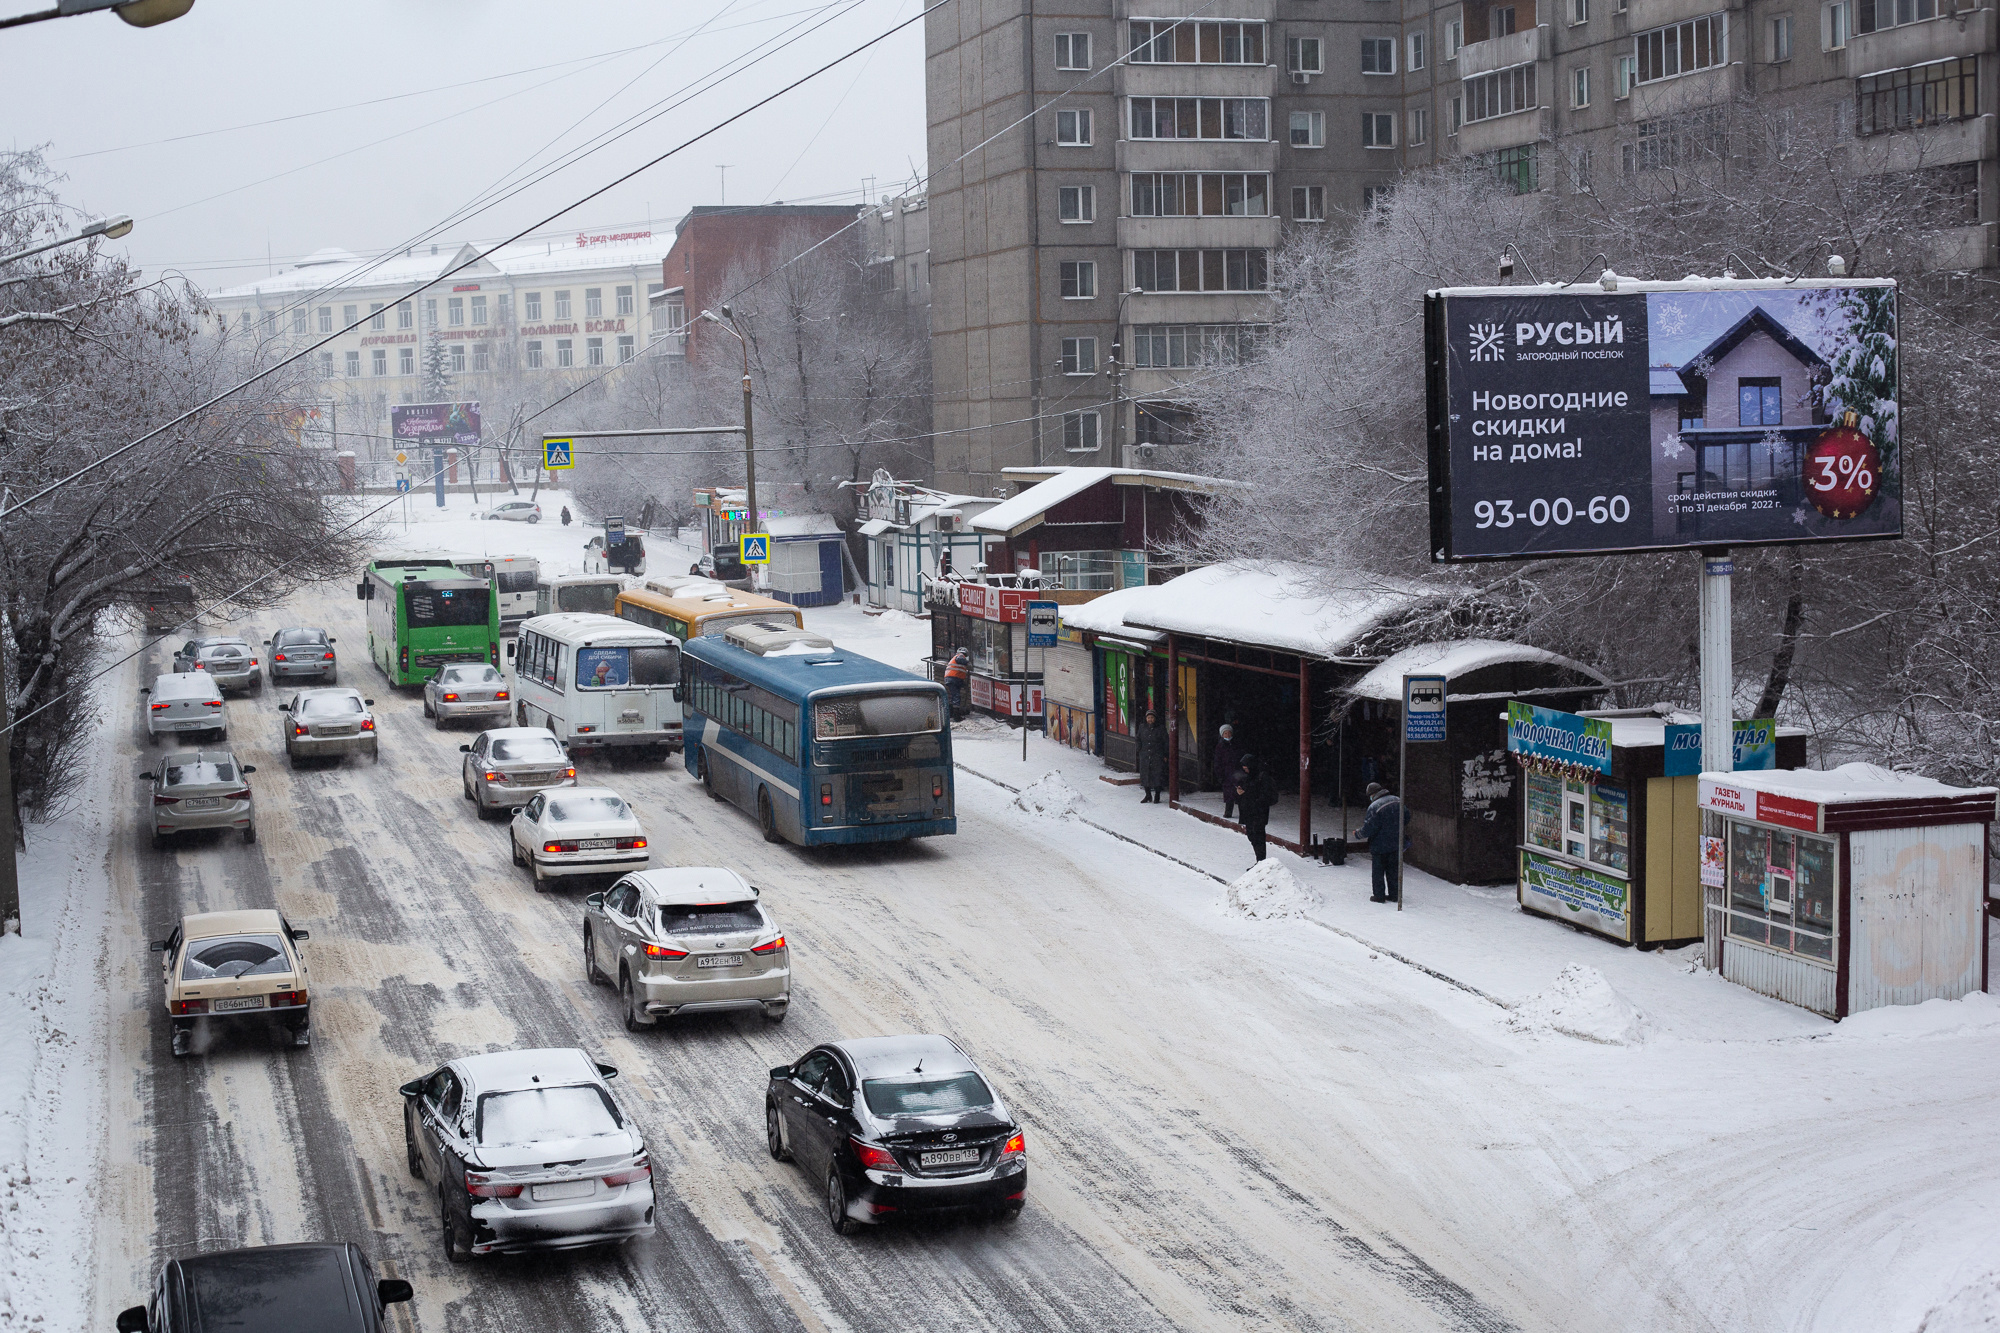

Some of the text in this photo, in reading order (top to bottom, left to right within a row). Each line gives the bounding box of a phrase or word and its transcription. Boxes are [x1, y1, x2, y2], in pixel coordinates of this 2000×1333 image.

[360, 333, 417, 347] ДОРОЖНАЯ
[520, 322, 579, 336] БОЛЬНИЦА
[585, 319, 626, 333] ВСЖД
[1516, 315, 1624, 346] РУСЫЙ
[1516, 349, 1624, 361] ЗАГОРОДНЫЙ ПОСЁЛОК
[1472, 390, 1628, 411] Новогодние
[1472, 418, 1566, 438] скидки
[1473, 437, 1582, 463] на дома!
[1814, 454, 1873, 491] 3%
[1667, 488, 1778, 502] срок действия скидки:
[1473, 494, 1631, 529] 93-00-60
[1668, 506, 1674, 514] с
[1675, 504, 1680, 513] 1
[1682, 505, 1694, 513] по
[1696, 503, 1705, 513] 31
[1706, 502, 1747, 513] декабря
[1751, 500, 1773, 510] 2022
[961, 587, 984, 606] РЕМОНТ
[1512, 719, 1607, 760] МОЛОЧНАЯ РЕКА
[1672, 728, 1768, 751] МОНАЯ
[1715, 786, 1741, 800] ГАЗЕТЫ
[1710, 796, 1745, 812] ЖУРНАЛЫ
[1529, 860, 1557, 877] МОЛОЧНАЯ
[1557, 869, 1571, 881] РЕКА
[1574, 887, 1584, 897] ВКУС
[1572, 898, 1581, 906] РУК
[1581, 900, 1599, 912] МЕСТНЫХ
[700, 956, 728, 966] А912ЕН
[218, 1000, 248, 1009] Е846НТ
[924, 1149, 976, 1164] А890ВВ 138
